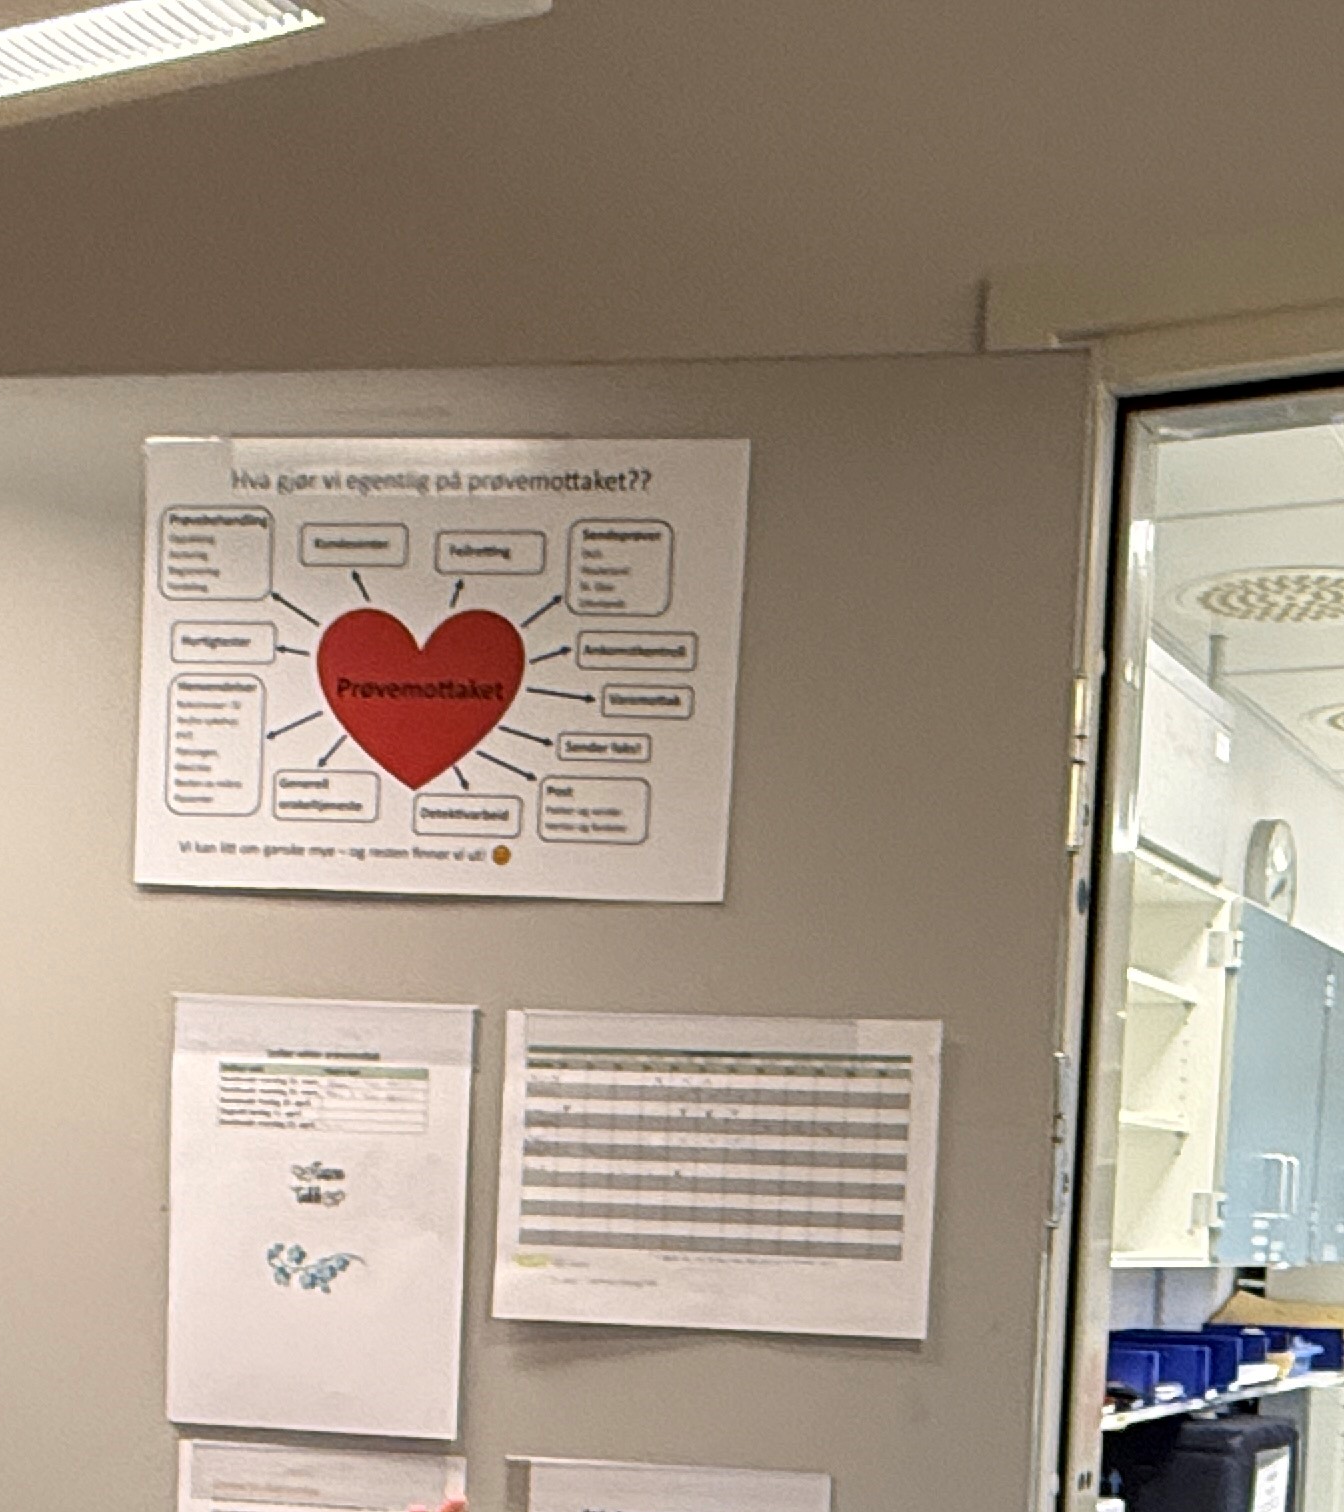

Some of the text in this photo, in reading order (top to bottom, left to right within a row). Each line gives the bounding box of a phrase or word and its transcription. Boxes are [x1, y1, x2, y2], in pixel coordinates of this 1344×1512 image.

[231, 467, 653, 497] Hva gjør vi egentlig på prøvemottaket??
[336, 676, 505, 701] Prøvemottaket
